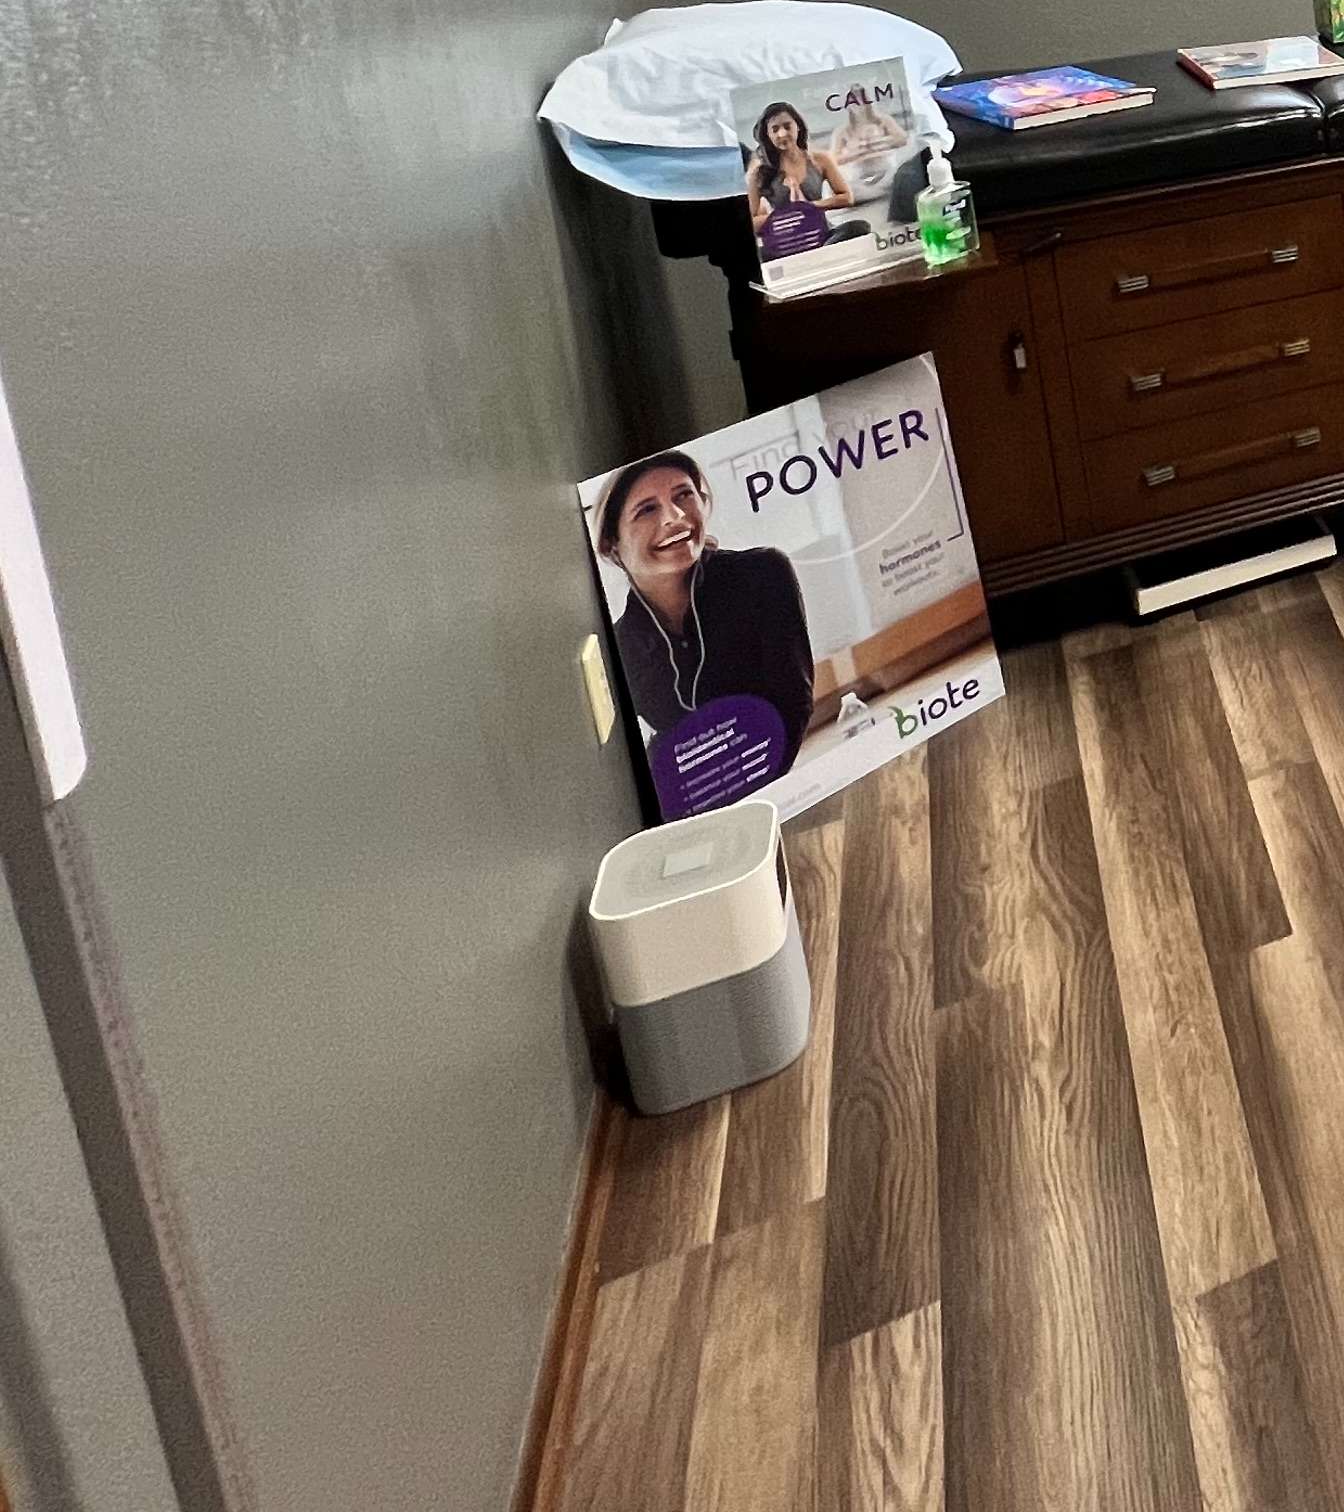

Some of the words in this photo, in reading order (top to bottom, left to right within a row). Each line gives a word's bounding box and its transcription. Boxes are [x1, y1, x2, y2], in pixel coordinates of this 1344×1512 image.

[825, 83, 893, 112] CALM
[746, 410, 929, 512] POWER
[879, 540, 942, 575] hormones
[887, 679, 980, 739] biote
